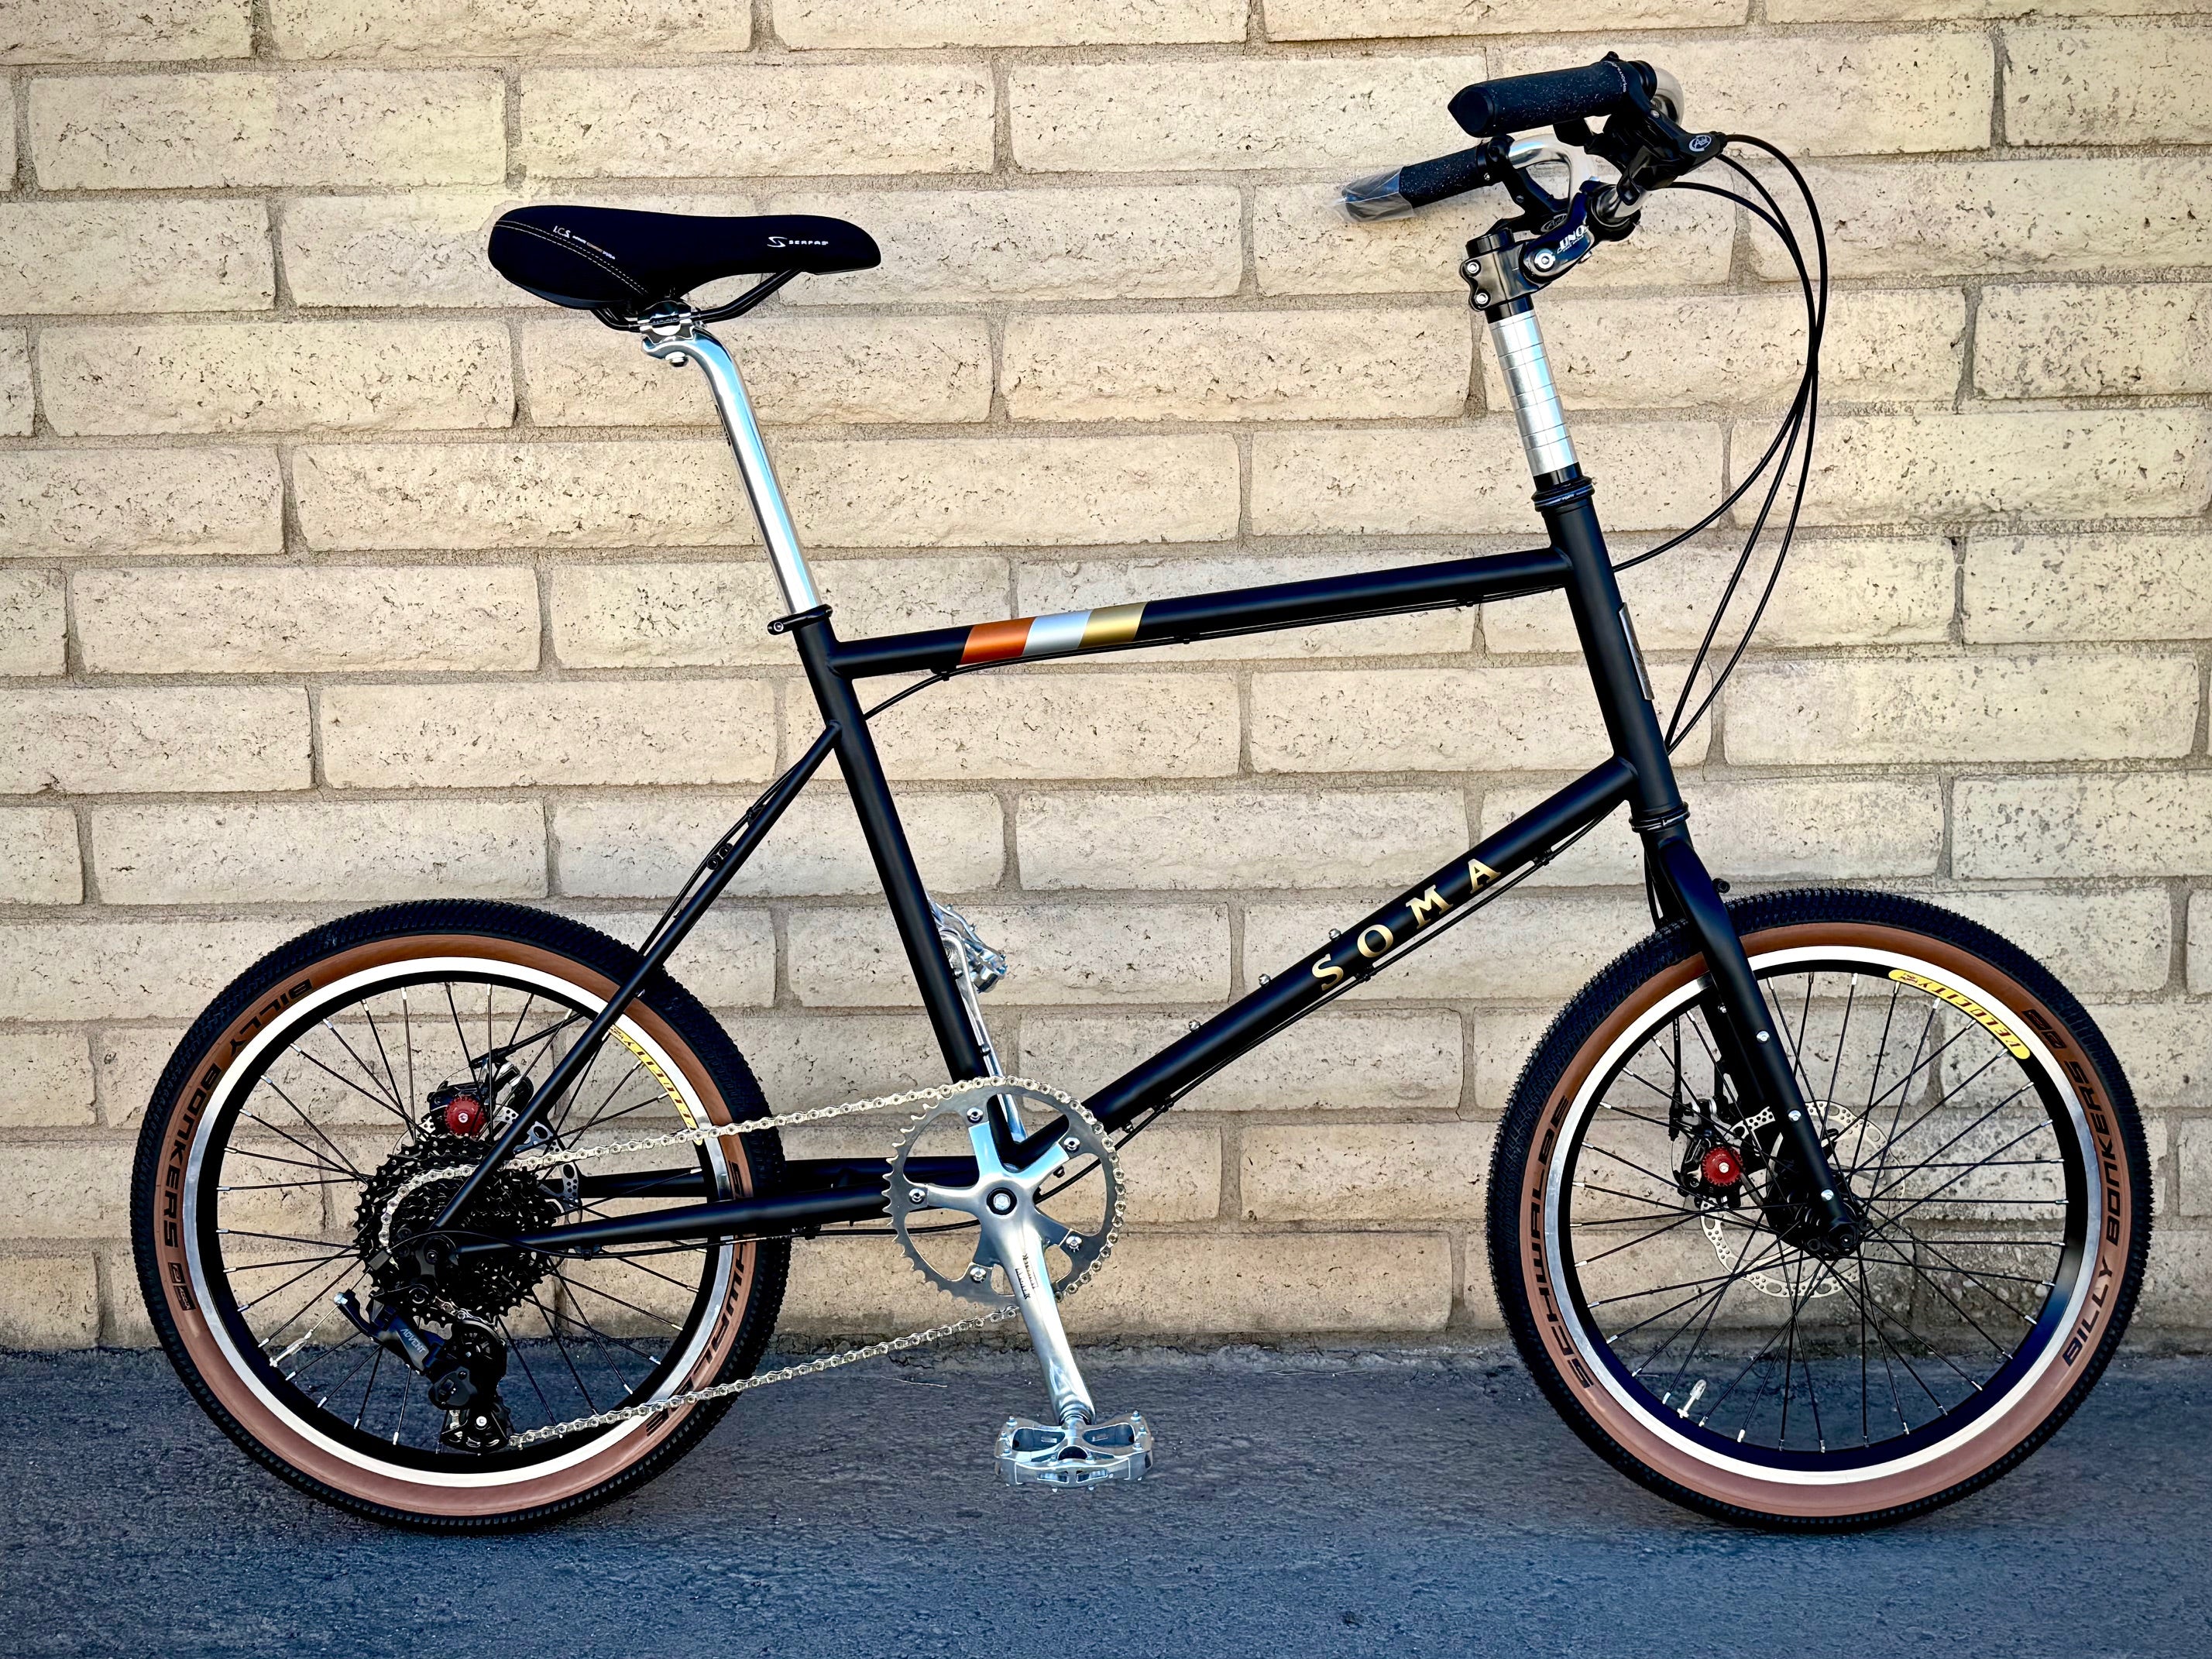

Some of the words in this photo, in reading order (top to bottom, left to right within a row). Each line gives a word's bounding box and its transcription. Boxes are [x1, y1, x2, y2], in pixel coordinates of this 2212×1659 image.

[1559, 225, 1585, 250] UNO
[1312, 858, 1501, 991] SOMA
[230, 978, 312, 1057] BILLY
[1918, 981, 2021, 1049] VELOCITY
[164, 1063, 222, 1248] BONKERS
[2064, 1060, 2121, 1245] BONKERS
[647, 1160, 745, 1437] SHWALE
[1530, 1095, 1595, 1389] SCHWALBE
[400, 1328, 428, 1353] ADVENT
[2063, 1255, 2113, 1367] BILLY
